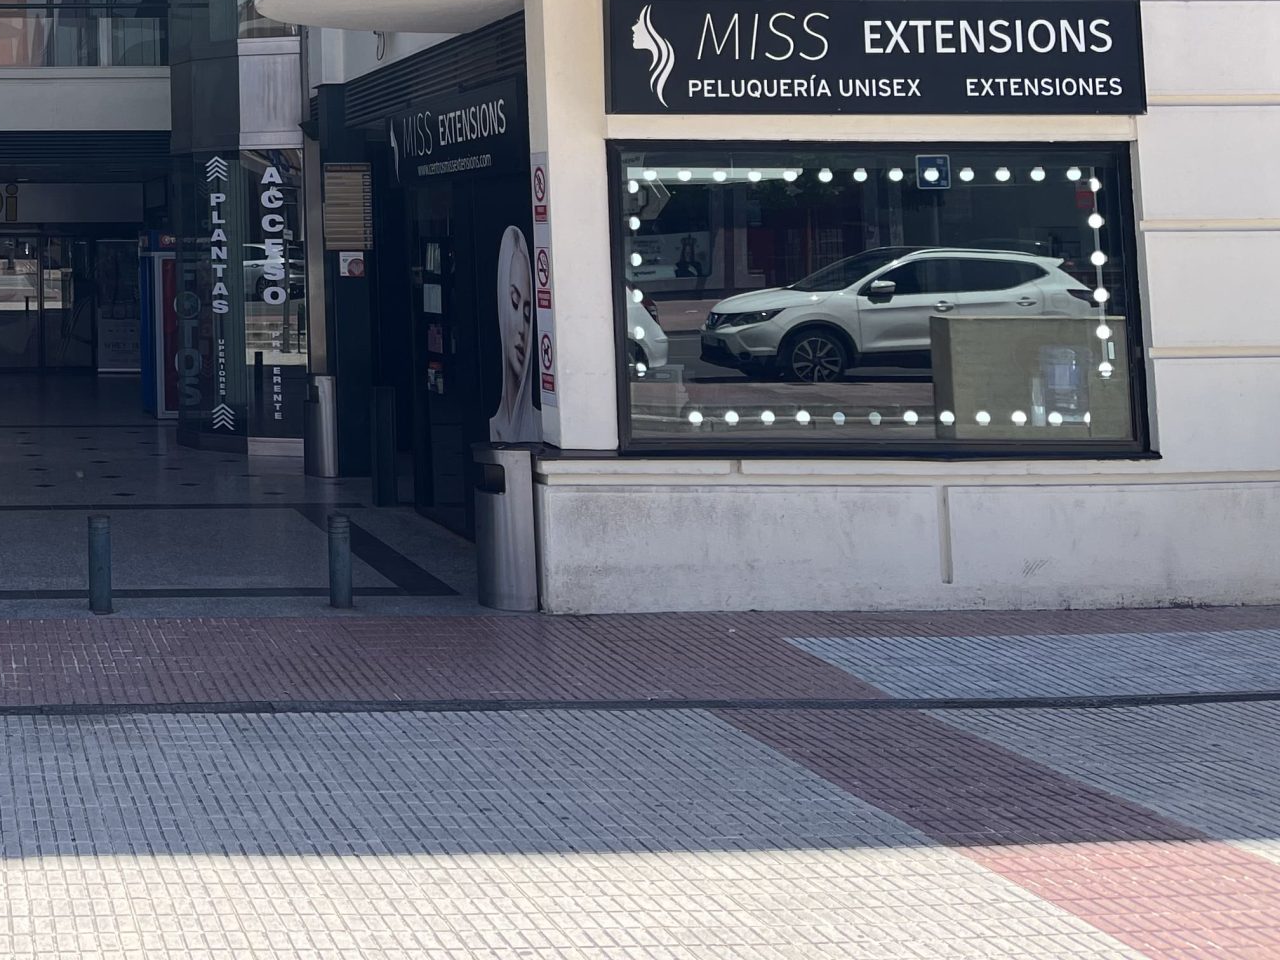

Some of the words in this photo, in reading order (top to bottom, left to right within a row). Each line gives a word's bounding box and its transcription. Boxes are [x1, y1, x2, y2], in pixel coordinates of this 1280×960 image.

[697, 12, 830, 61] MISS
[863, 18, 1114, 54] EXTENSIONS
[688, 74, 832, 100] PELUQUERÍA
[838, 78, 921, 98] UNISEX
[965, 77, 1123, 97] EXTENSIONES
[403, 110, 433, 159] MISS
[438, 98, 507, 146] EXTENSIONS
[210, 193, 229, 314] PLANTAS
[261, 166, 287, 305] ACCESO
